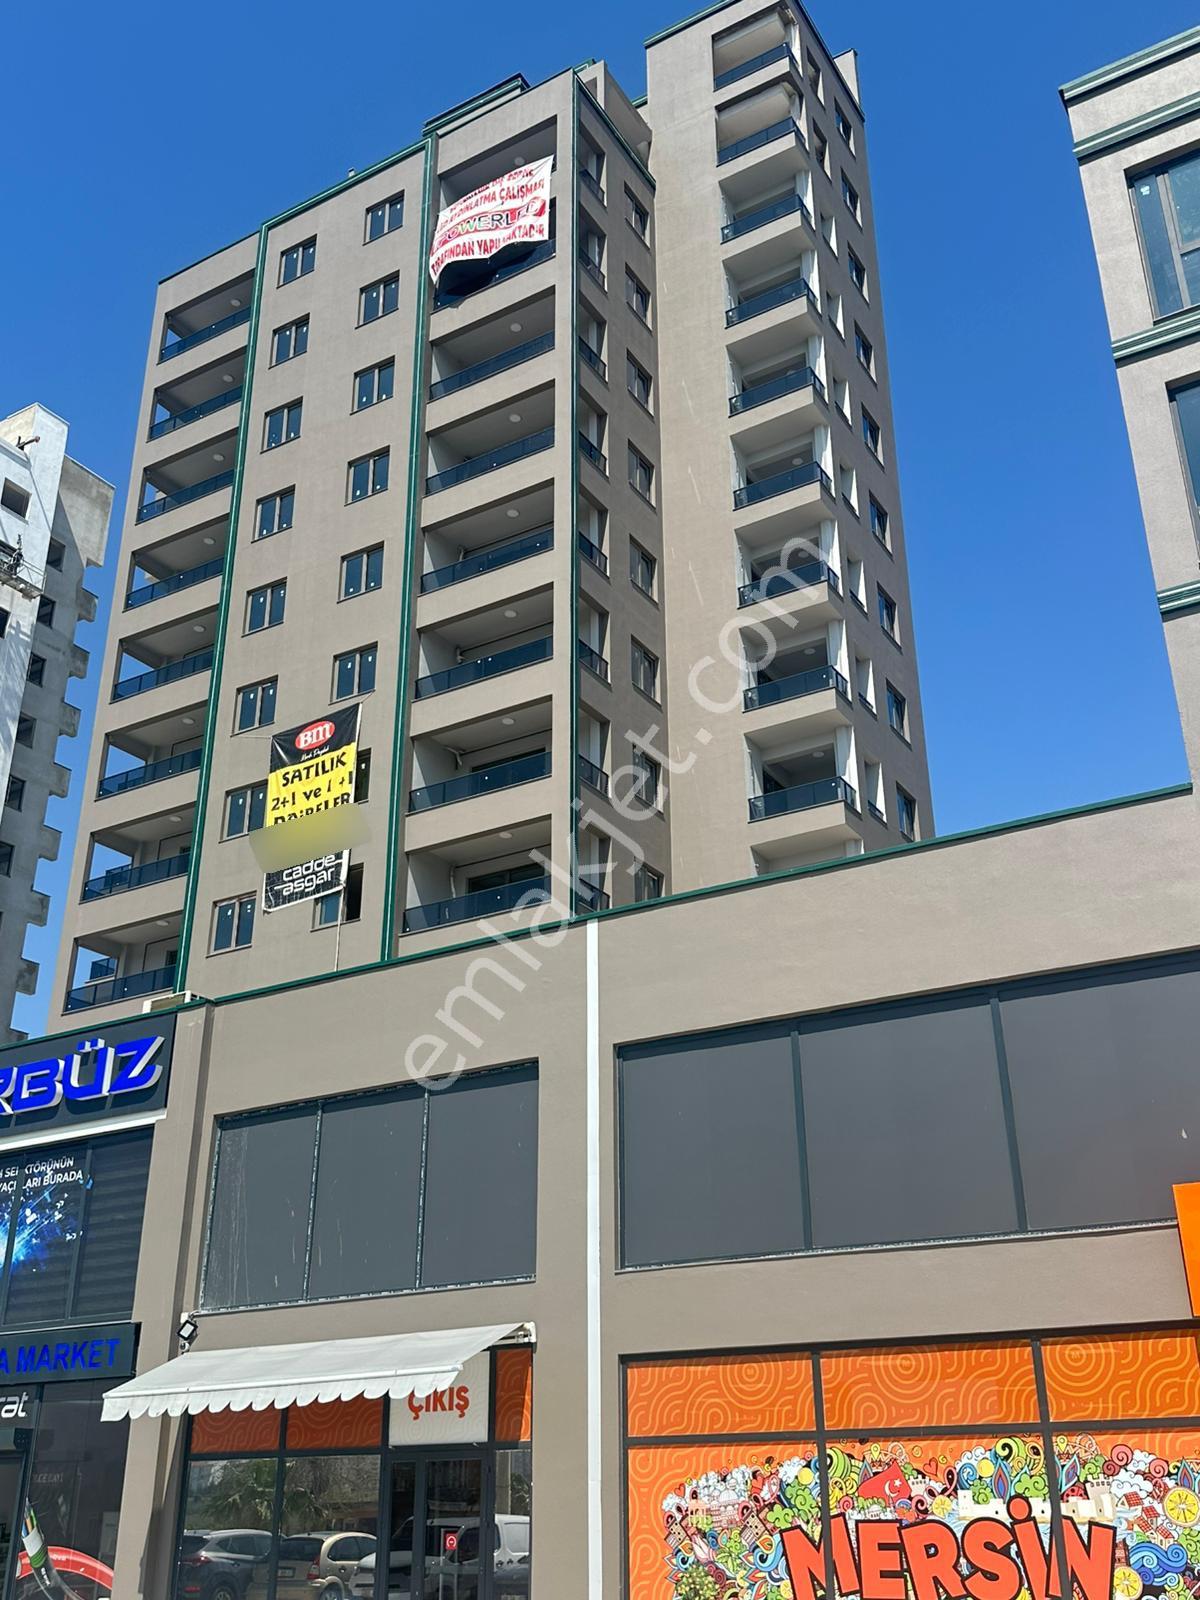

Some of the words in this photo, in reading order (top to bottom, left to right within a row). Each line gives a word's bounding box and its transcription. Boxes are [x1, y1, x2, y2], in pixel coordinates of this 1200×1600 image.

[282, 751, 347, 787] SATILIK
[302, 787, 322, 801] ve
[42, 1169, 84, 1186] BURADA
[16, 1338, 121, 1374] MARKET
[407, 1385, 470, 1420] ÇIKIŞ
[779, 1495, 1117, 1600] MERSİN
